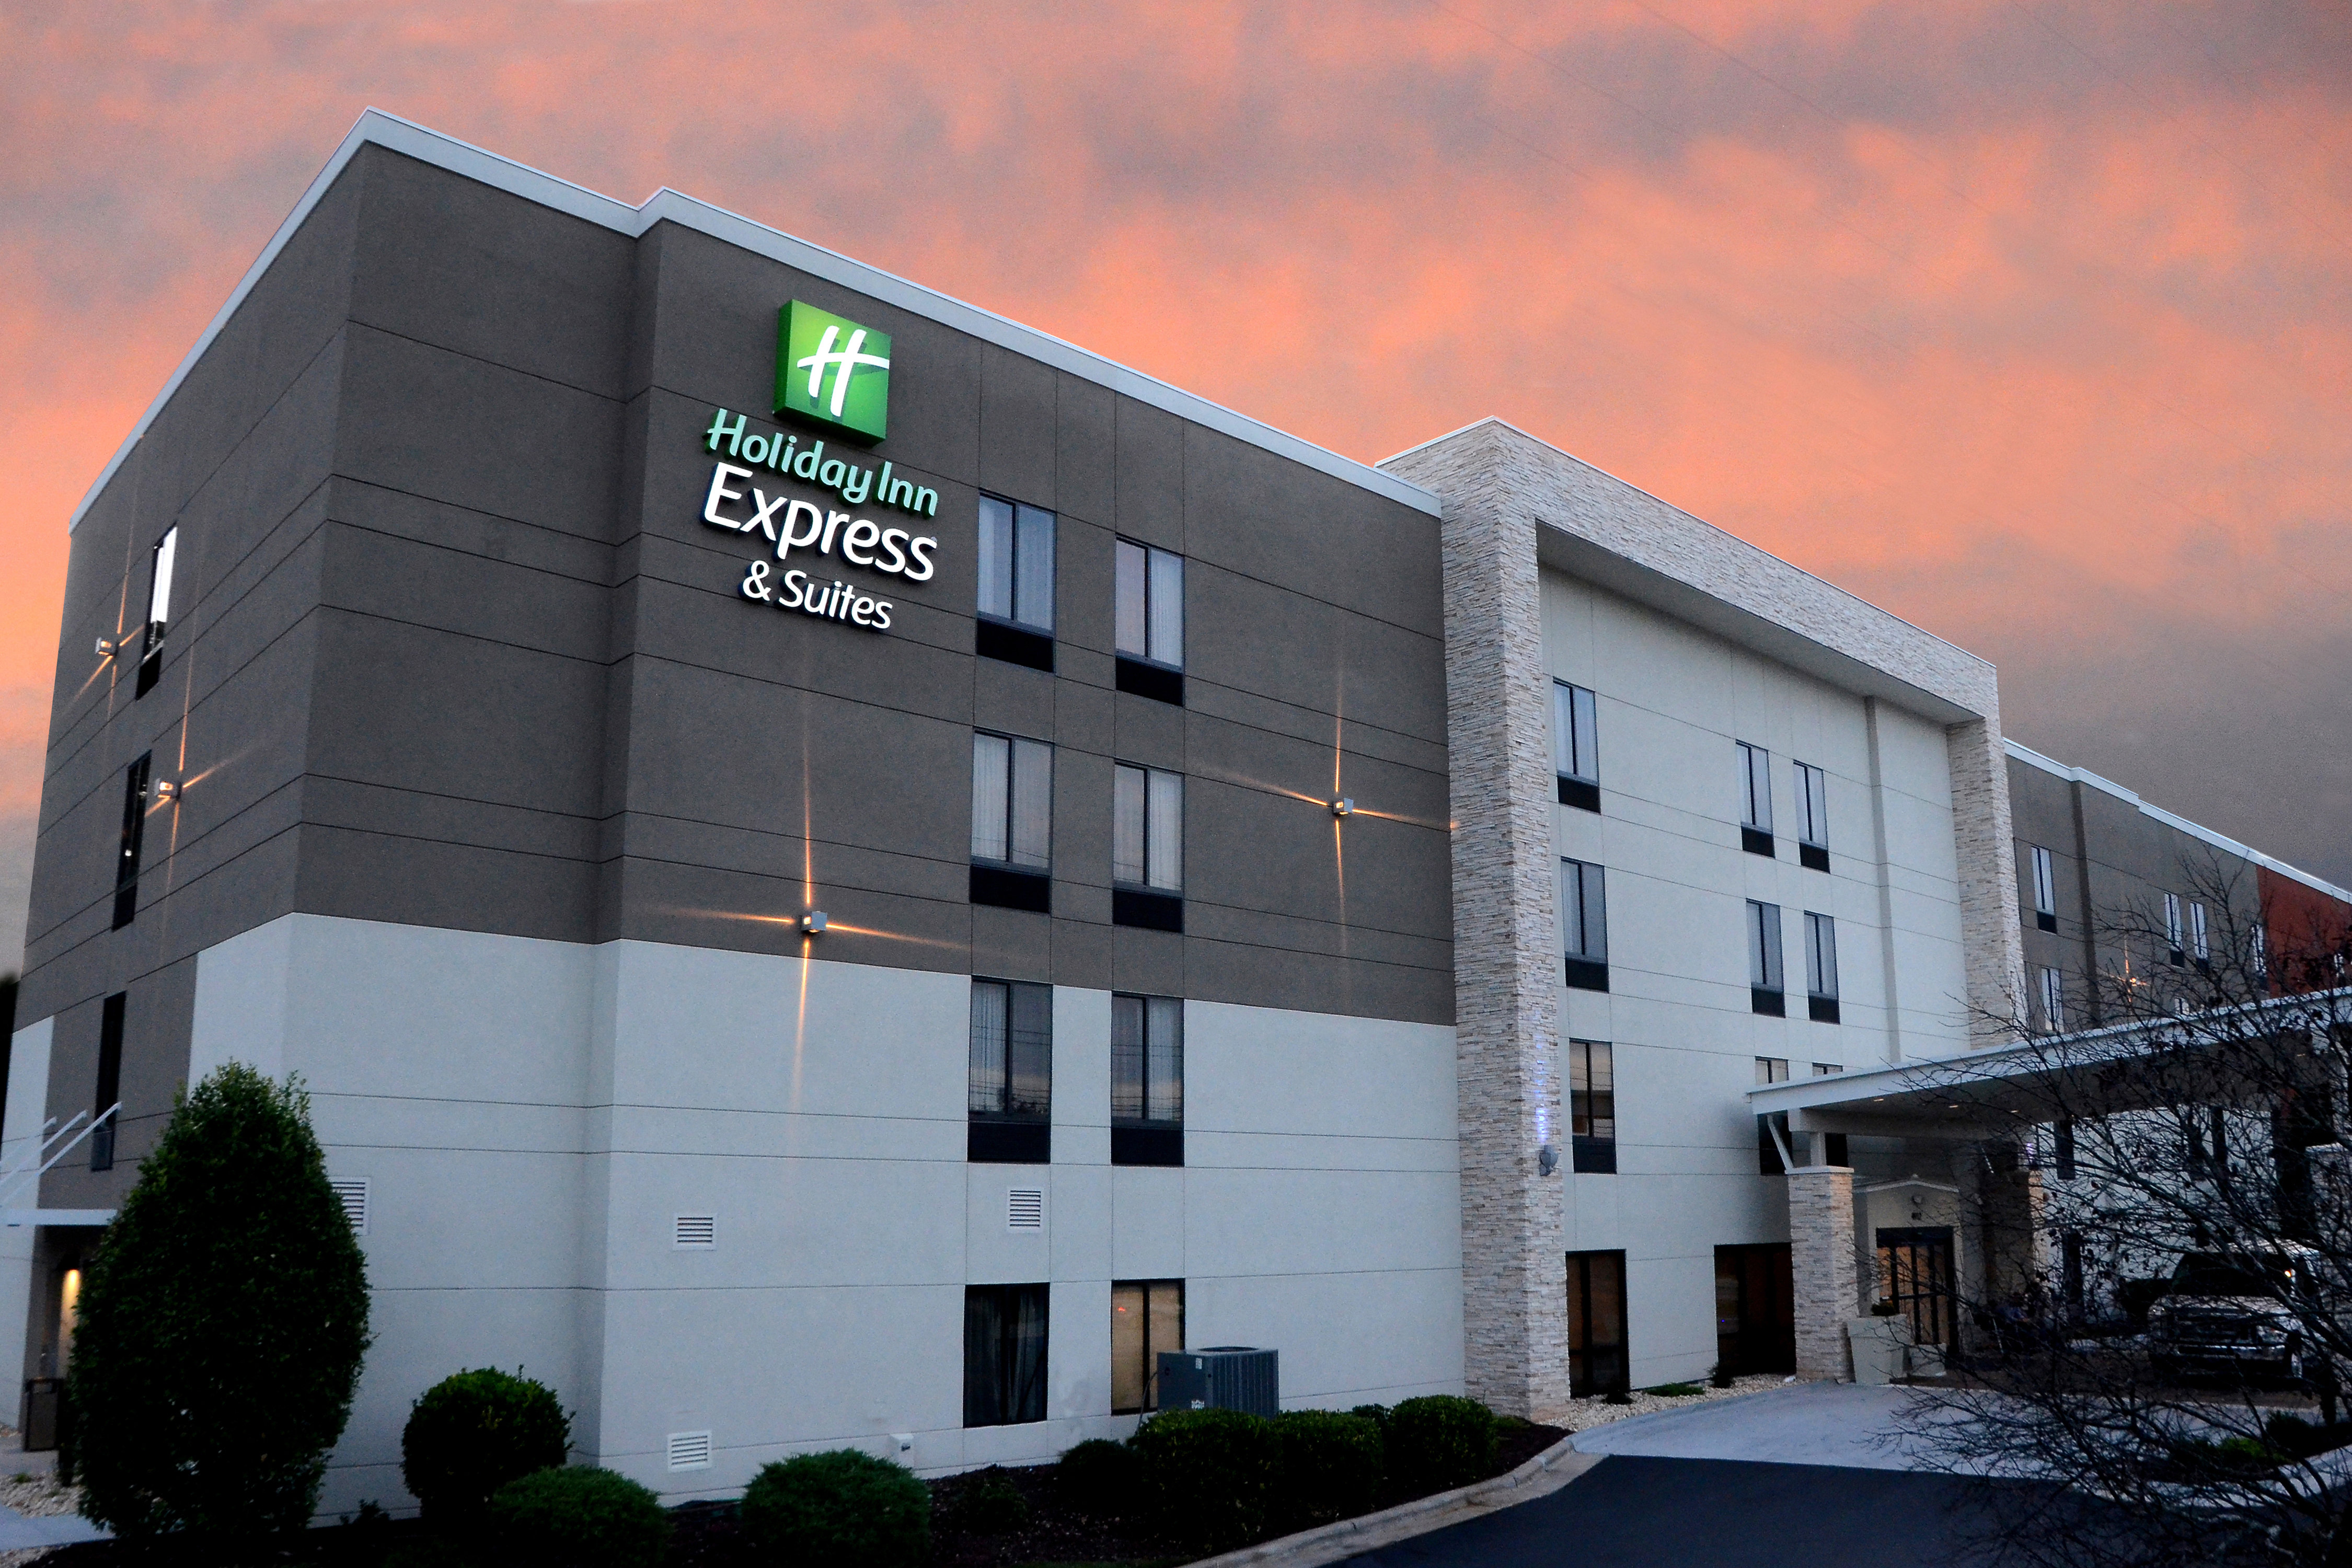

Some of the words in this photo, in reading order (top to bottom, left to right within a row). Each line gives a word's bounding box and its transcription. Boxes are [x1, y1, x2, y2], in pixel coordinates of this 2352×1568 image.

[707, 408, 872, 503] Holiday
[878, 462, 938, 516] Inn
[704, 462, 937, 581] Express
[743, 560, 771, 601] &
[779, 570, 893, 629] Suites
